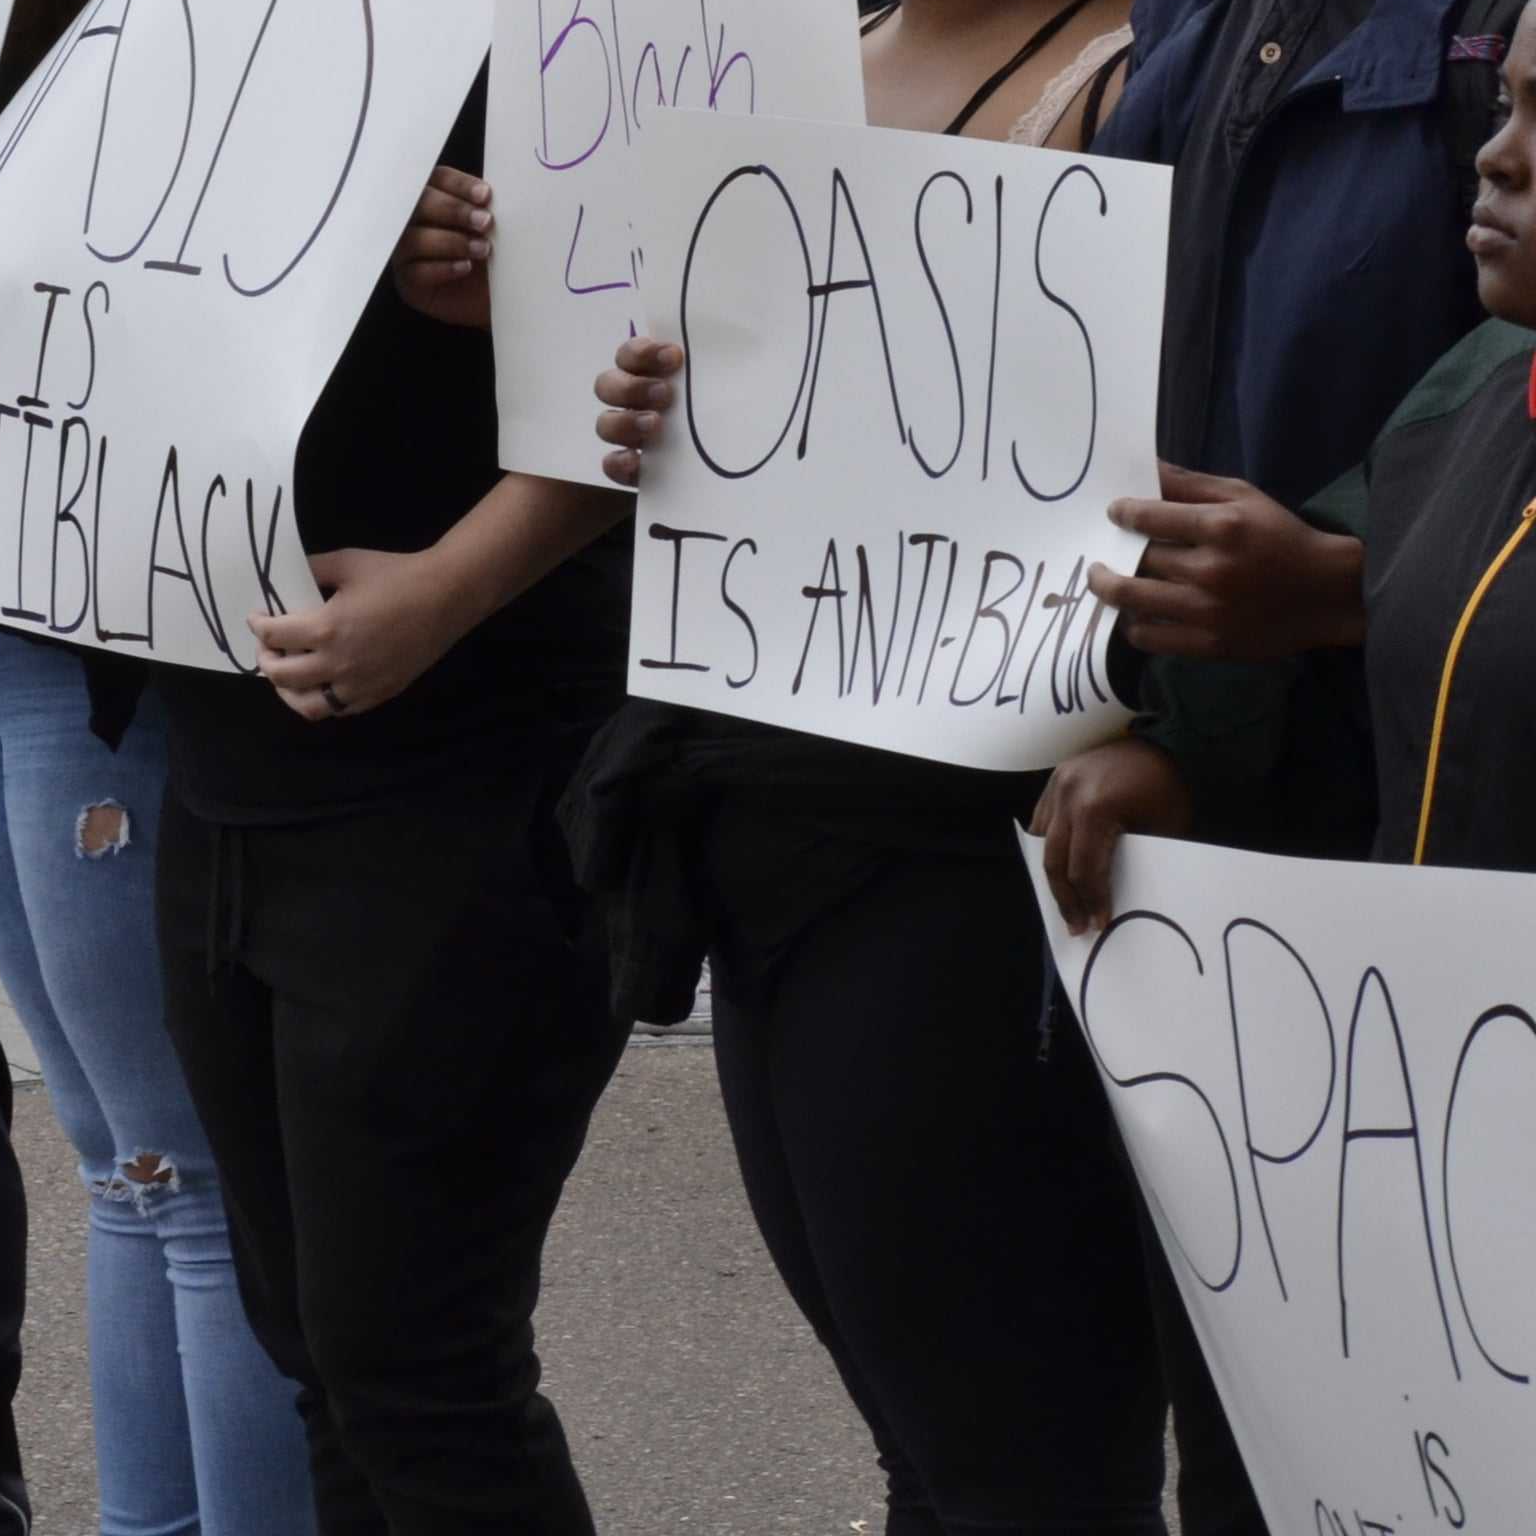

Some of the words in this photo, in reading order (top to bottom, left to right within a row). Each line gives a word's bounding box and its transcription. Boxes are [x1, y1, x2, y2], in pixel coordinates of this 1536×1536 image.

[14, 280, 111, 411] IS
[680, 163, 1108, 502] OASIS
[639, 524, 761, 689] IS
[1413, 1428, 1466, 1531] IS
